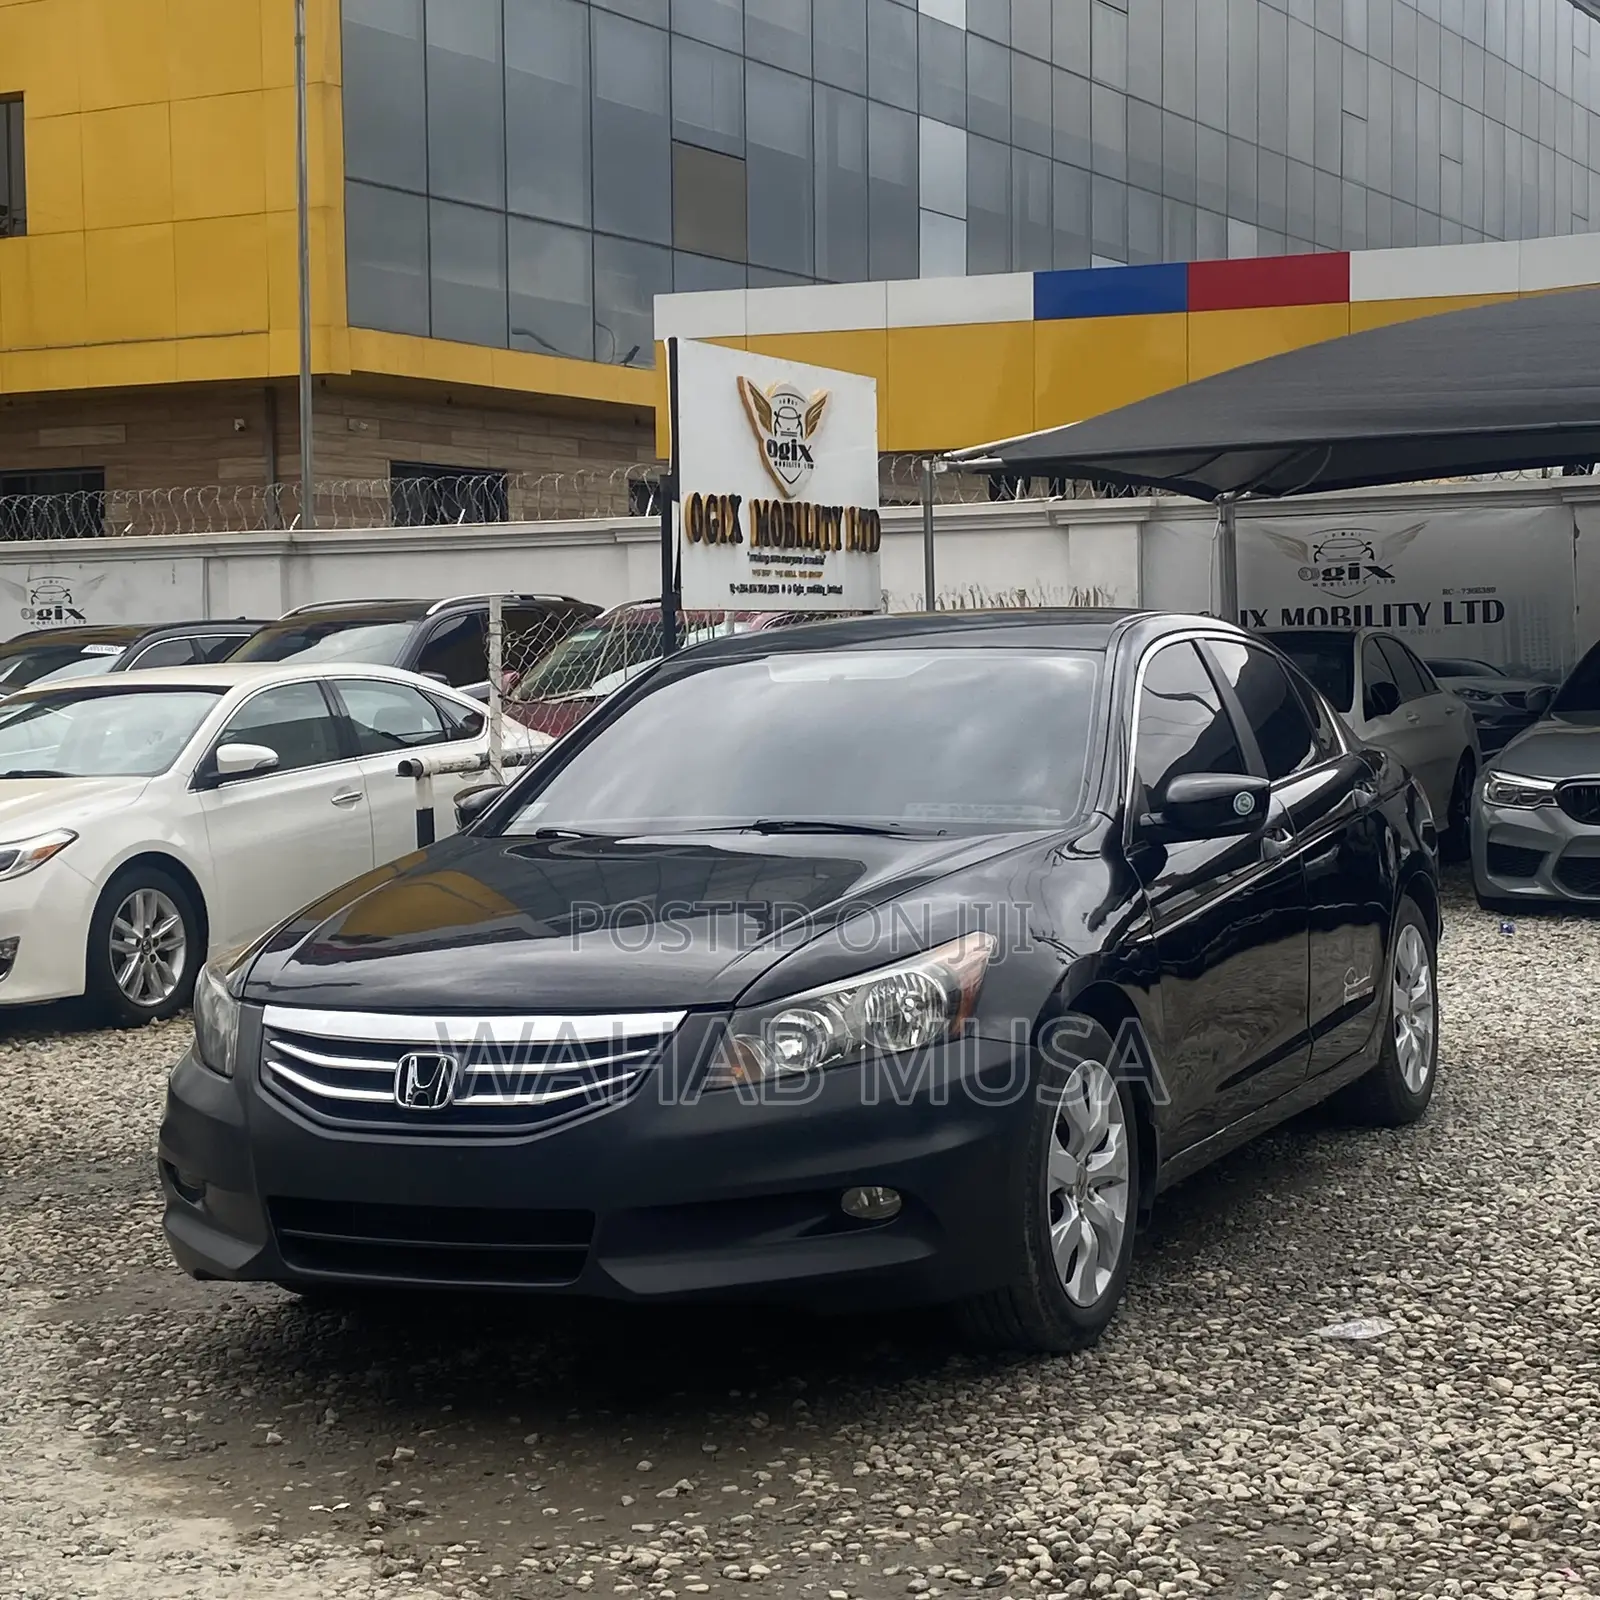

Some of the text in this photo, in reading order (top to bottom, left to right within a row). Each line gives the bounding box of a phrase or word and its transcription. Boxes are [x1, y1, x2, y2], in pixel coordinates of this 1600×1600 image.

[685, 492, 744, 545] OGIX
[749, 499, 843, 552] MOBILITY
[1282, 602, 1431, 627] MOBILITY
[1443, 600, 1505, 625] LTD
